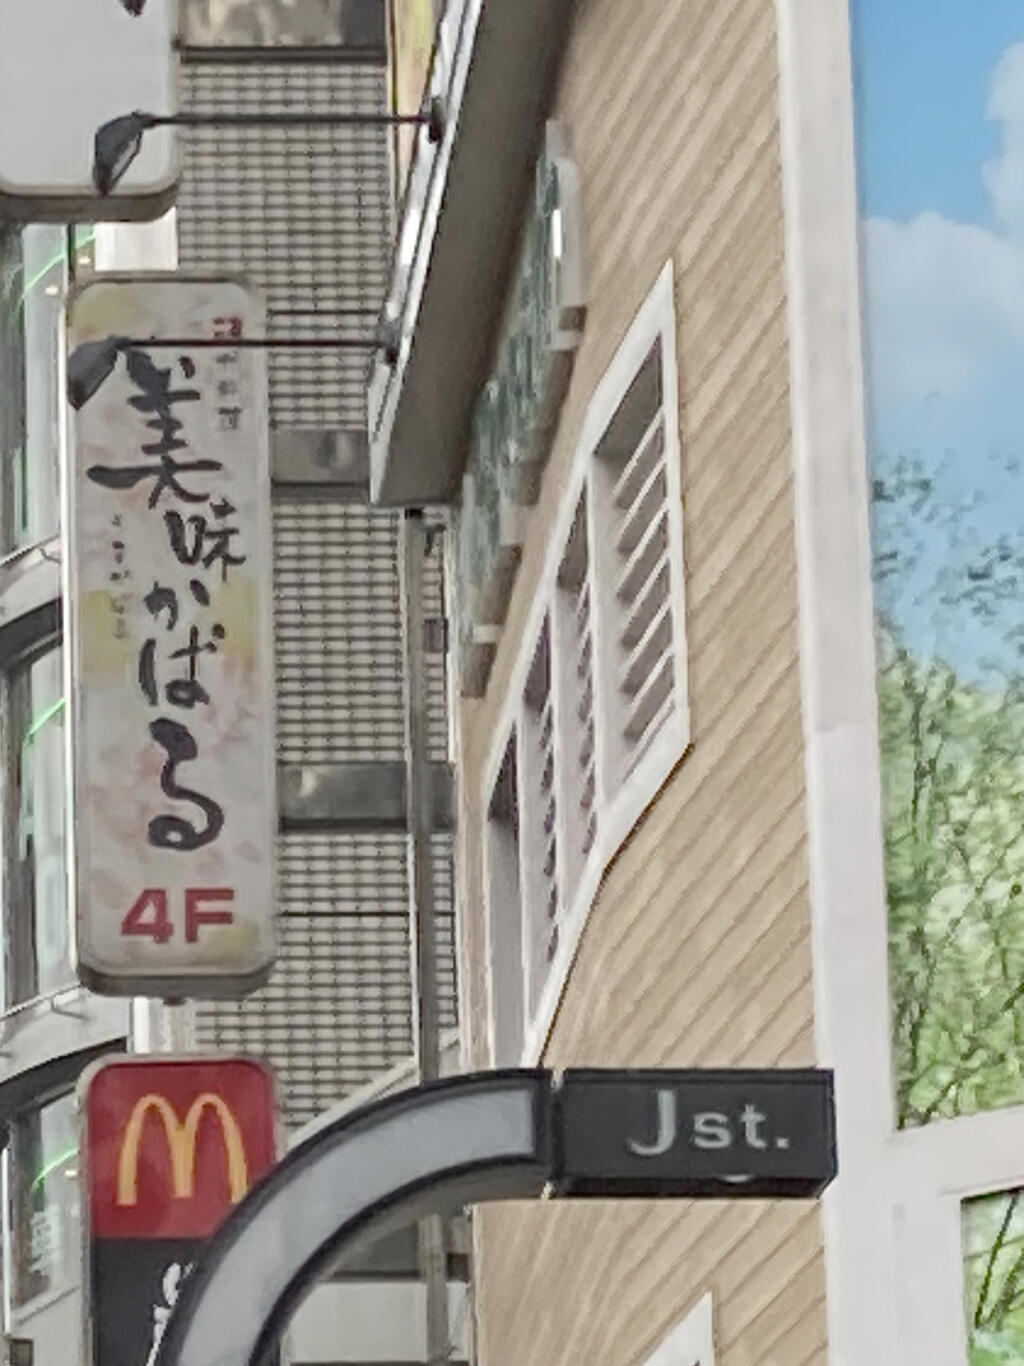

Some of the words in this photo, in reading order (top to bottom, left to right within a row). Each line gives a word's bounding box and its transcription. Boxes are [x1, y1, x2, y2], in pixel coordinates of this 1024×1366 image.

[121, 888, 235, 944] 4F
[629, 1089, 676, 1156] J
[693, 1103, 790, 1149] st.
